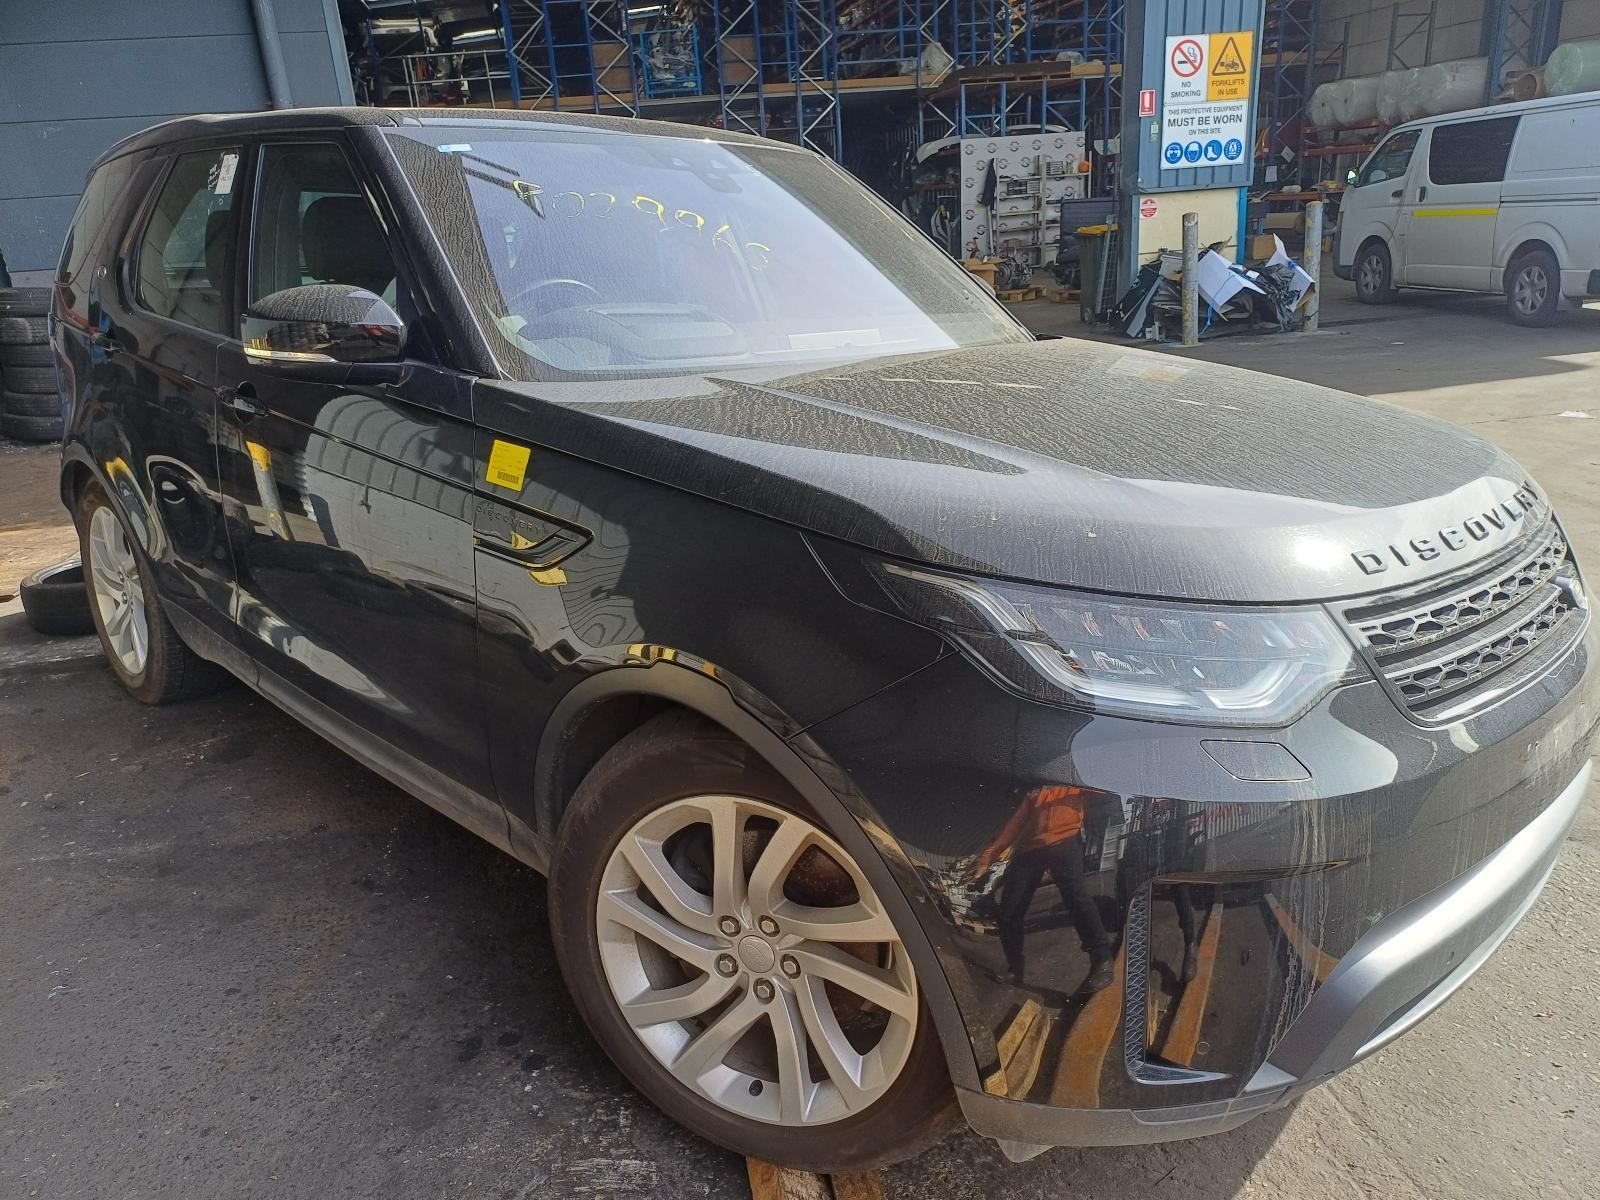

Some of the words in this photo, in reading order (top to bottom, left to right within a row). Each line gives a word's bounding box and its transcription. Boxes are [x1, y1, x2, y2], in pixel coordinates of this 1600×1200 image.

[1211, 79, 1245, 87] FORKLIFTS
[1170, 89, 1201, 98] SMOKING
[1180, 106, 1213, 115] PROTECTIVE
[1213, 105, 1243, 113] EQUIPMENT
[1167, 117, 1195, 127] MUST
[1197, 116, 1210, 126] BE
[1213, 114, 1243, 124] WORN
[1351, 479, 1539, 576] DISCOVERY
